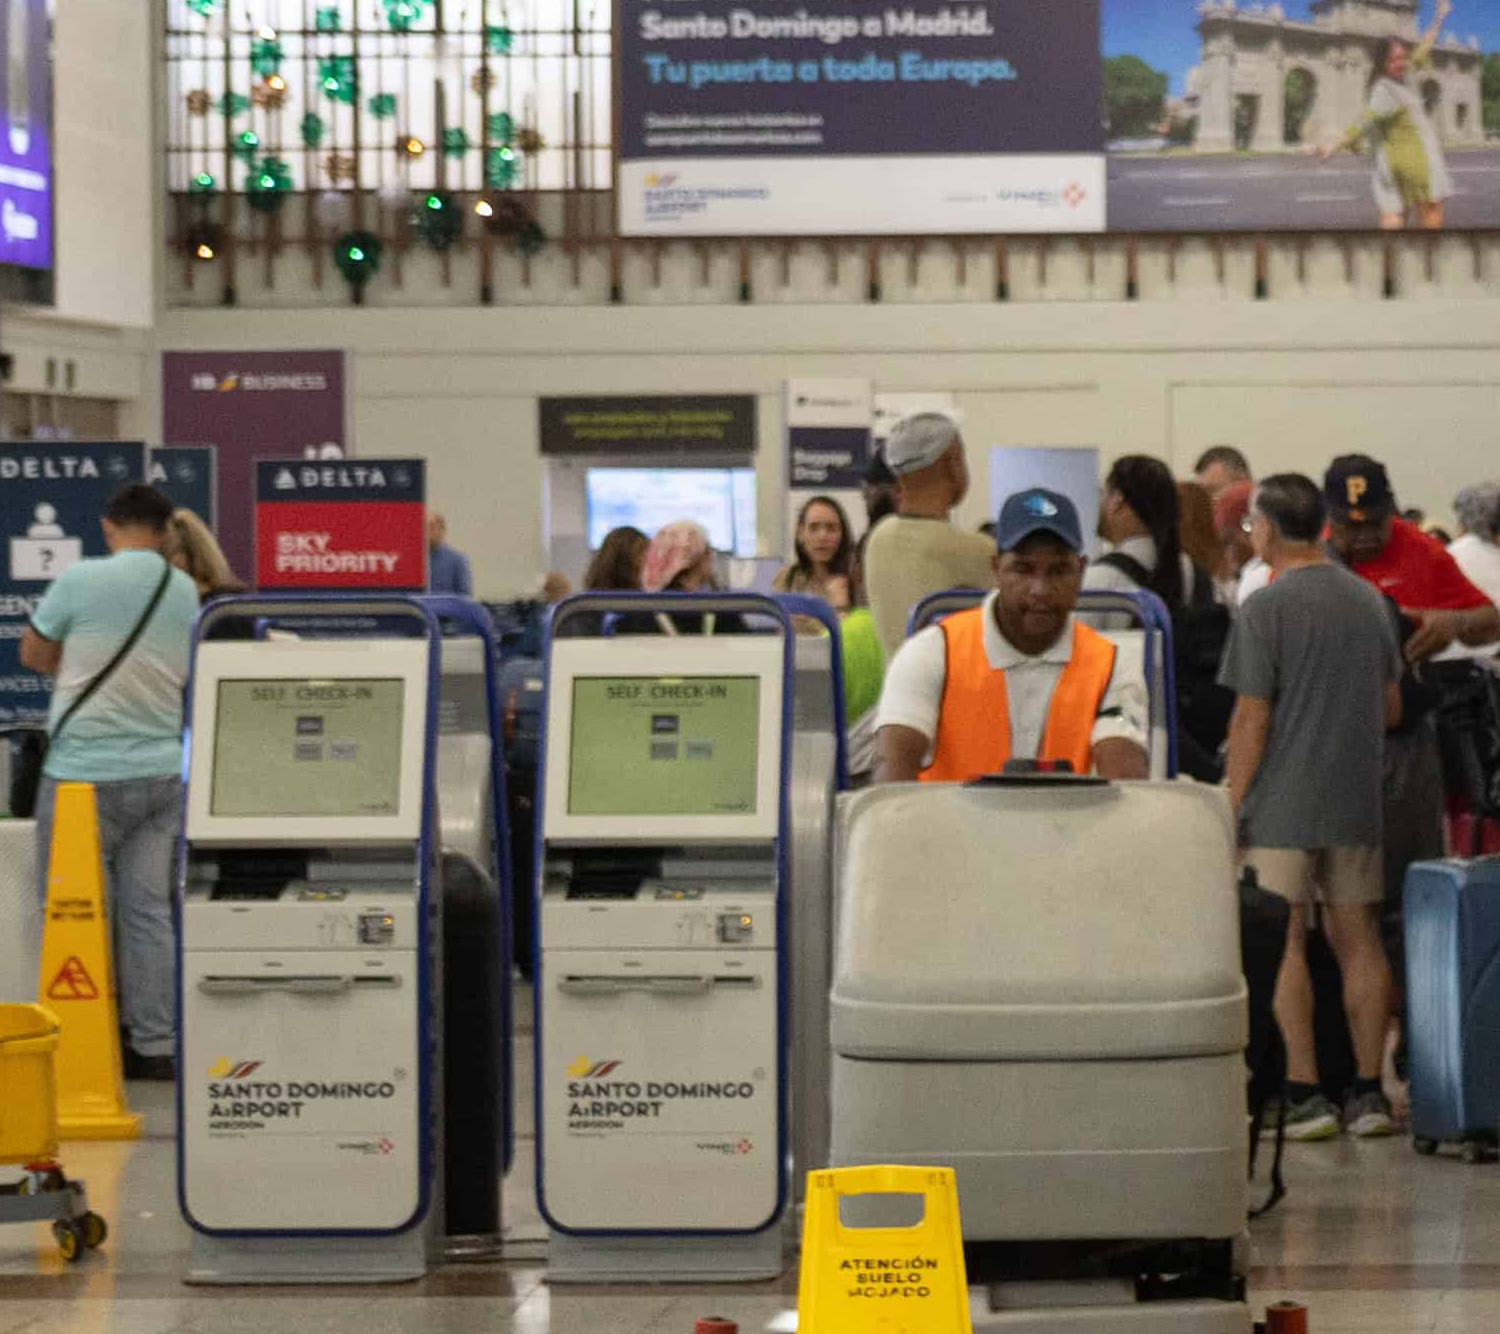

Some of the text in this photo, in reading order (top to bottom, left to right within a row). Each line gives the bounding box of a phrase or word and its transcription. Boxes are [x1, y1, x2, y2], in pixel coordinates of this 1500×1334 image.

[640, 10, 994, 43] Santo Domingo a Madrid.
[643, 52, 1016, 88] Tu puerta a toda Europa.
[243, 373, 327, 390] BUSINESS
[0, 456, 99, 479] DELTA
[301, 467, 386, 488] DELTA
[1346, 475, 1367, 505] P
[276, 533, 330, 554] SKY
[276, 553, 398, 573] PRIORITY
[296, 686, 373, 701] CHECK-IN
[606, 684, 728, 699] SELF CHECK-IN
[208, 1082, 283, 1099] SANTO
[567, 1082, 642, 1099] SANTO
[841, 1255, 938, 1269] ATENCIÓN
[857, 1273, 921, 1284] SUELO
